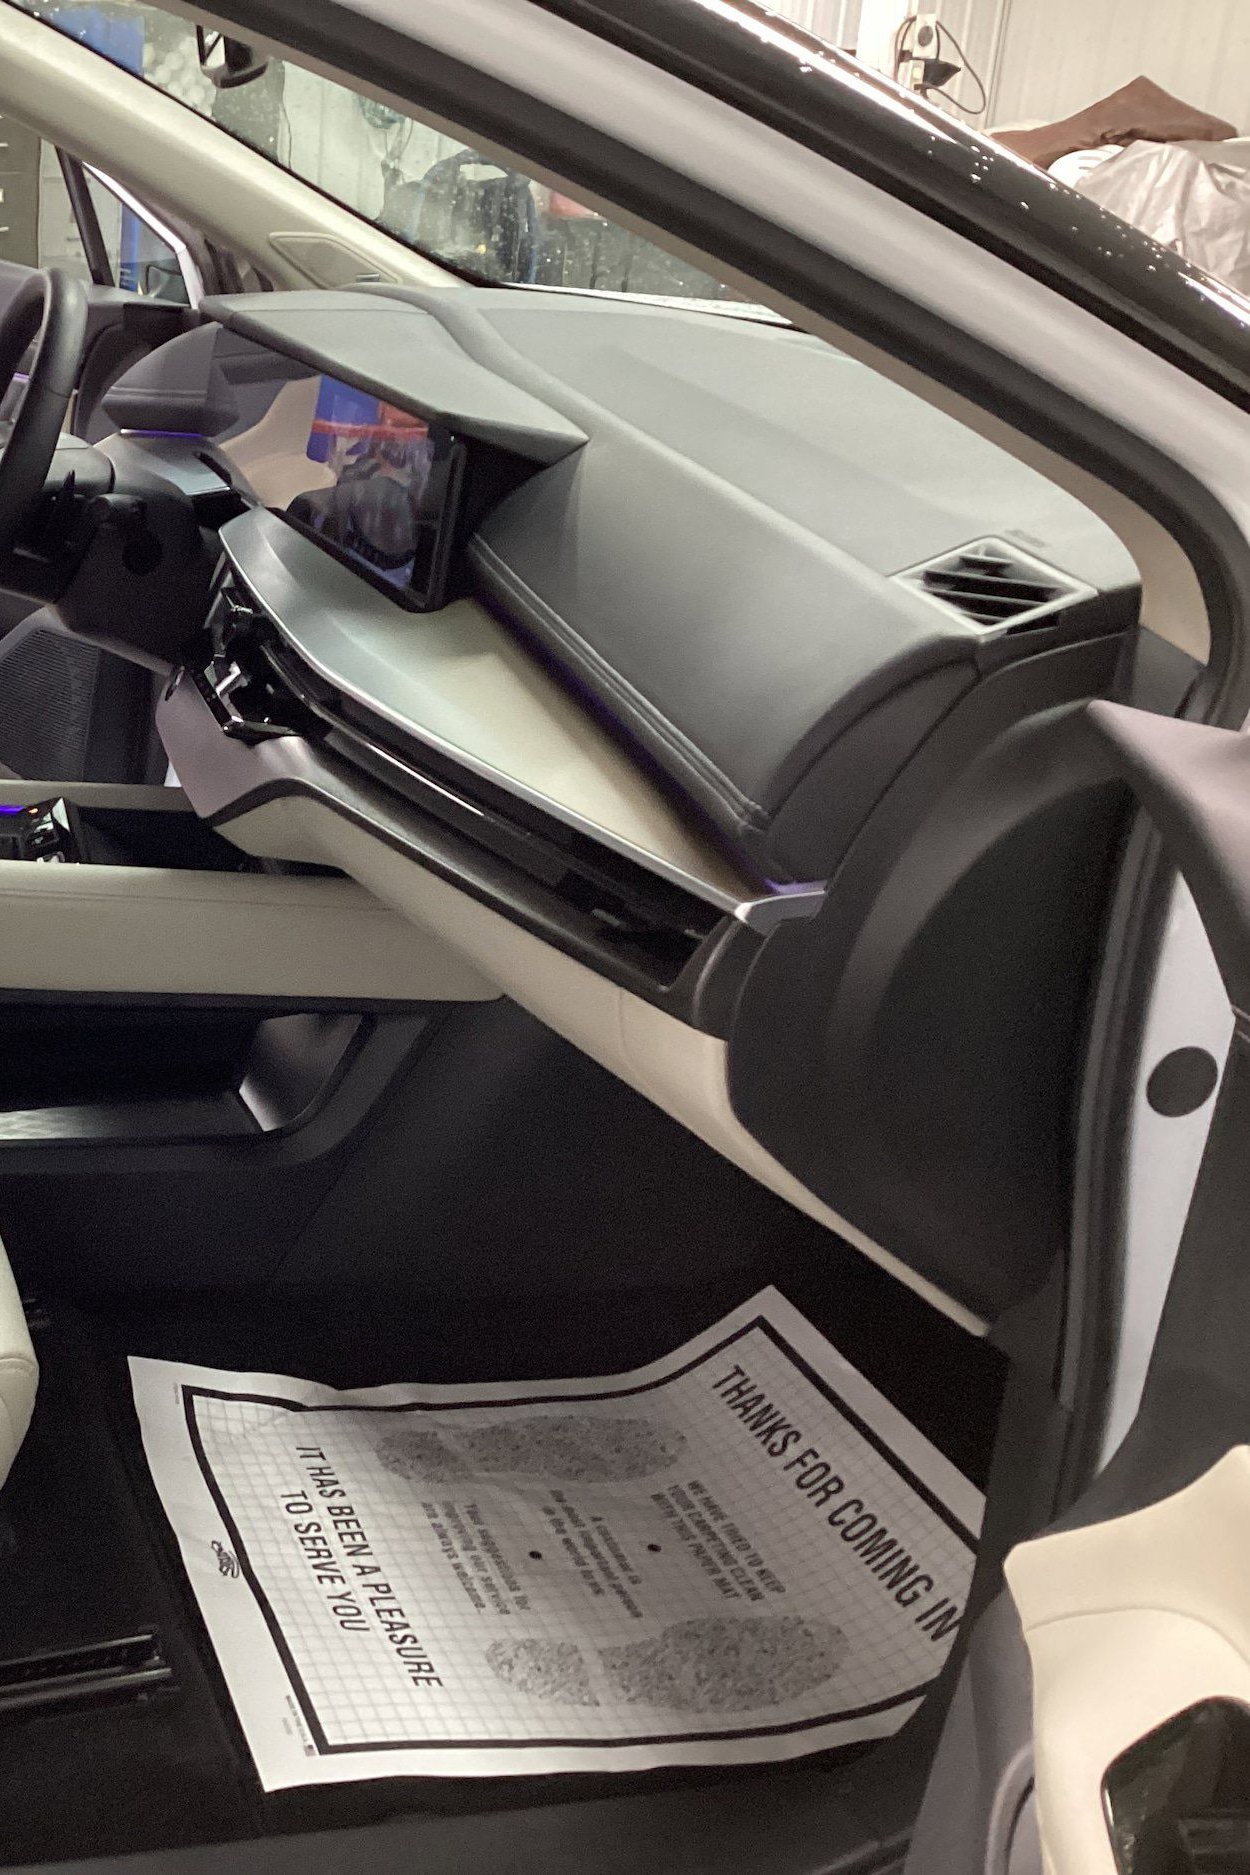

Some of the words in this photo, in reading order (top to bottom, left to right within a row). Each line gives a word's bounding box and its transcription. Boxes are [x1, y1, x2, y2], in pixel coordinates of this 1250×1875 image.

[296, 1447, 327, 1461] IT
[306, 1466, 347, 1499] HAS
[280, 1490, 313, 1514] TO
[327, 1505, 373, 1557] BEEN
[422, 1502, 438, 1519] are
[431, 1522, 459, 1560] always
[712, 1364, 802, 1457] THANKS
[784, 1447, 845, 1508] FOR
[828, 1499, 934, 1608] COMING
[915, 1597, 961, 1642] IN
[293, 1521, 346, 1585] SERVE
[477, 1528, 521, 1592] suggestions
[651, 1492, 678, 1519] WITH
[672, 1519, 697, 1541] THIS
[689, 1542, 722, 1576] PAPER
[712, 1576, 742, 1599] MAT
[668, 1485, 695, 1511] YOUR
[687, 1511, 738, 1567] CARPETING
[730, 1566, 765, 1601] CLEAN
[688, 1480, 707, 1496] WE
[703, 1496, 728, 1522] HAVE
[721, 1522, 751, 1551] TRIED
[745, 1552, 764, 1567] TO
[756, 1568, 786, 1593] KEEP
[352, 1564, 382, 1577] A
[470, 1555, 488, 1573] our
[481, 1576, 511, 1614] service
[326, 1591, 371, 1632] YOU
[362, 1583, 444, 1688] PLEASURE
